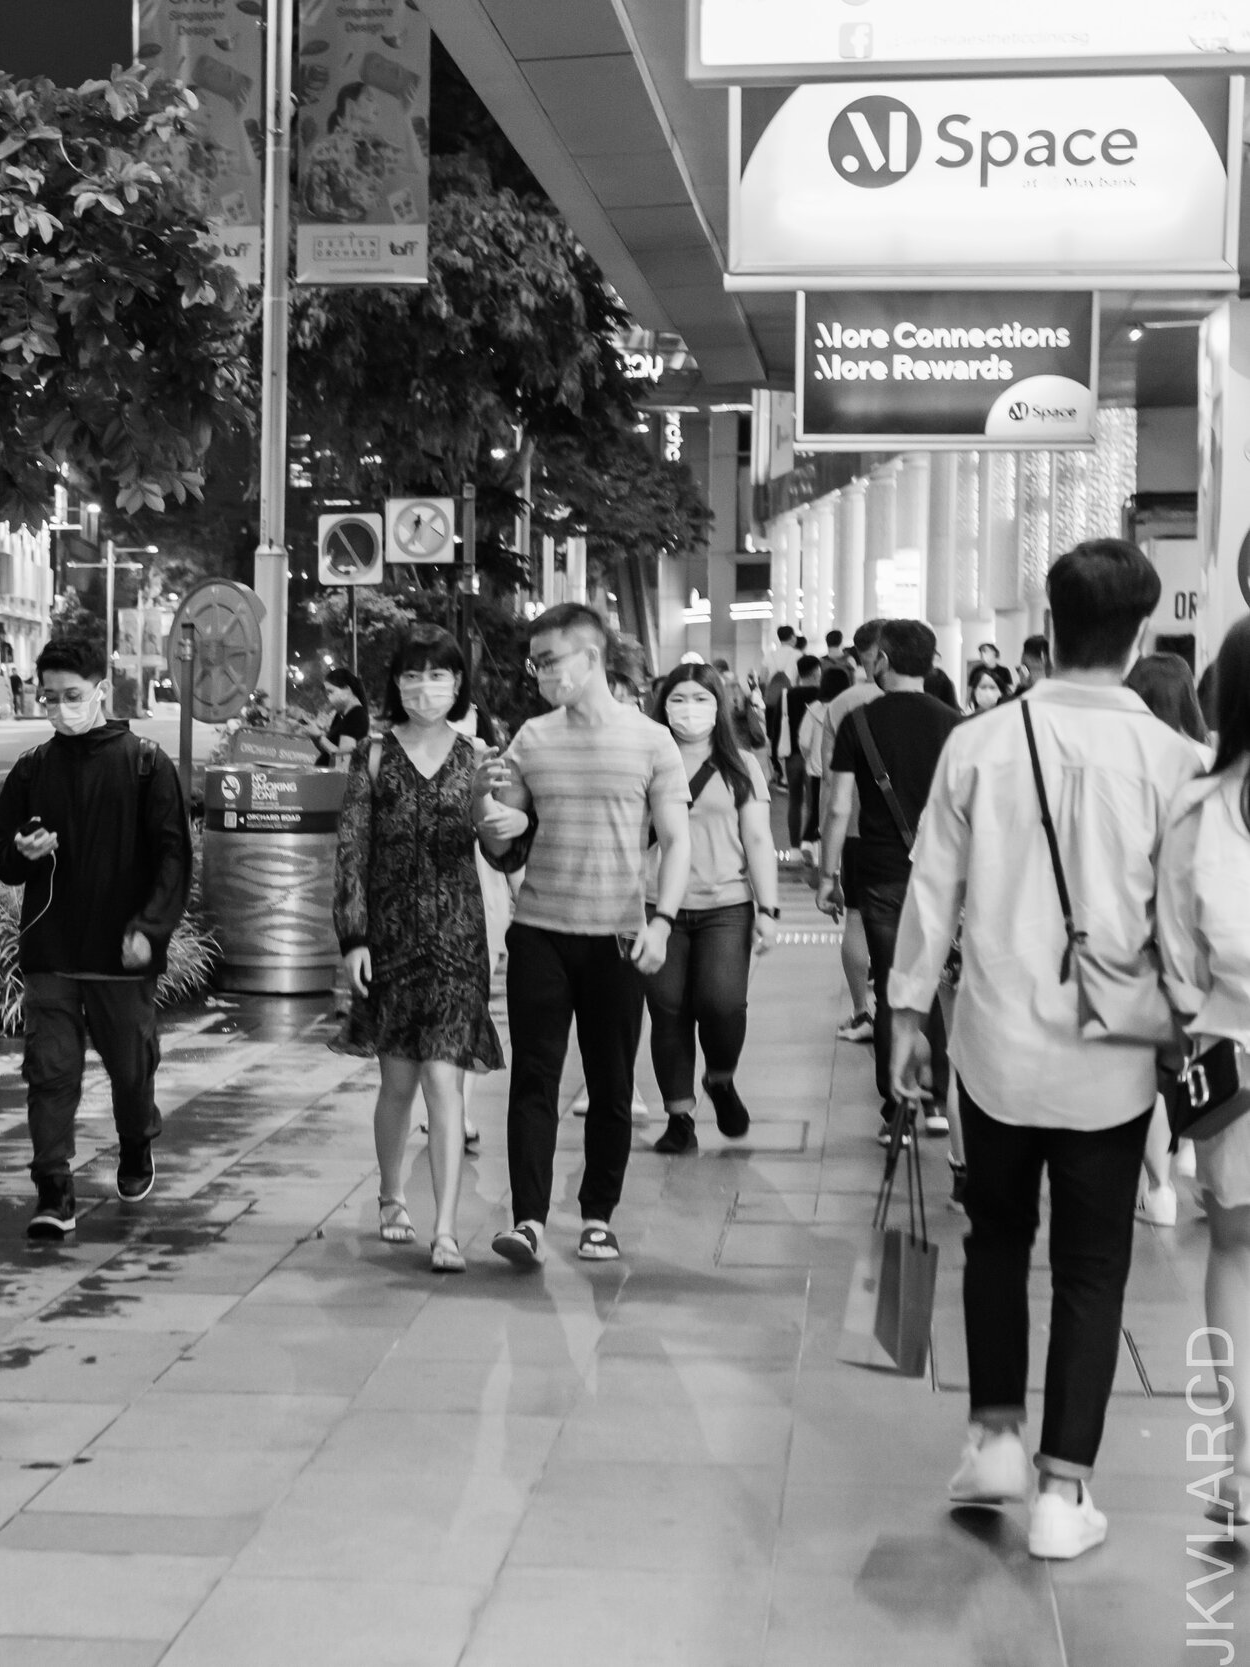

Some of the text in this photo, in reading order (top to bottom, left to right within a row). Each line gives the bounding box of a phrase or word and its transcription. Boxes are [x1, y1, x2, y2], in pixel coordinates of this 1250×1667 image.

[935, 114, 1138, 188] Space
[893, 321, 1071, 349] Connections
[893, 353, 1014, 381] Rewards
[251, 773, 267, 782] NO
[251, 782, 297, 792] SMOKING
[246, 813, 301, 822] ORCHARD ROAD
